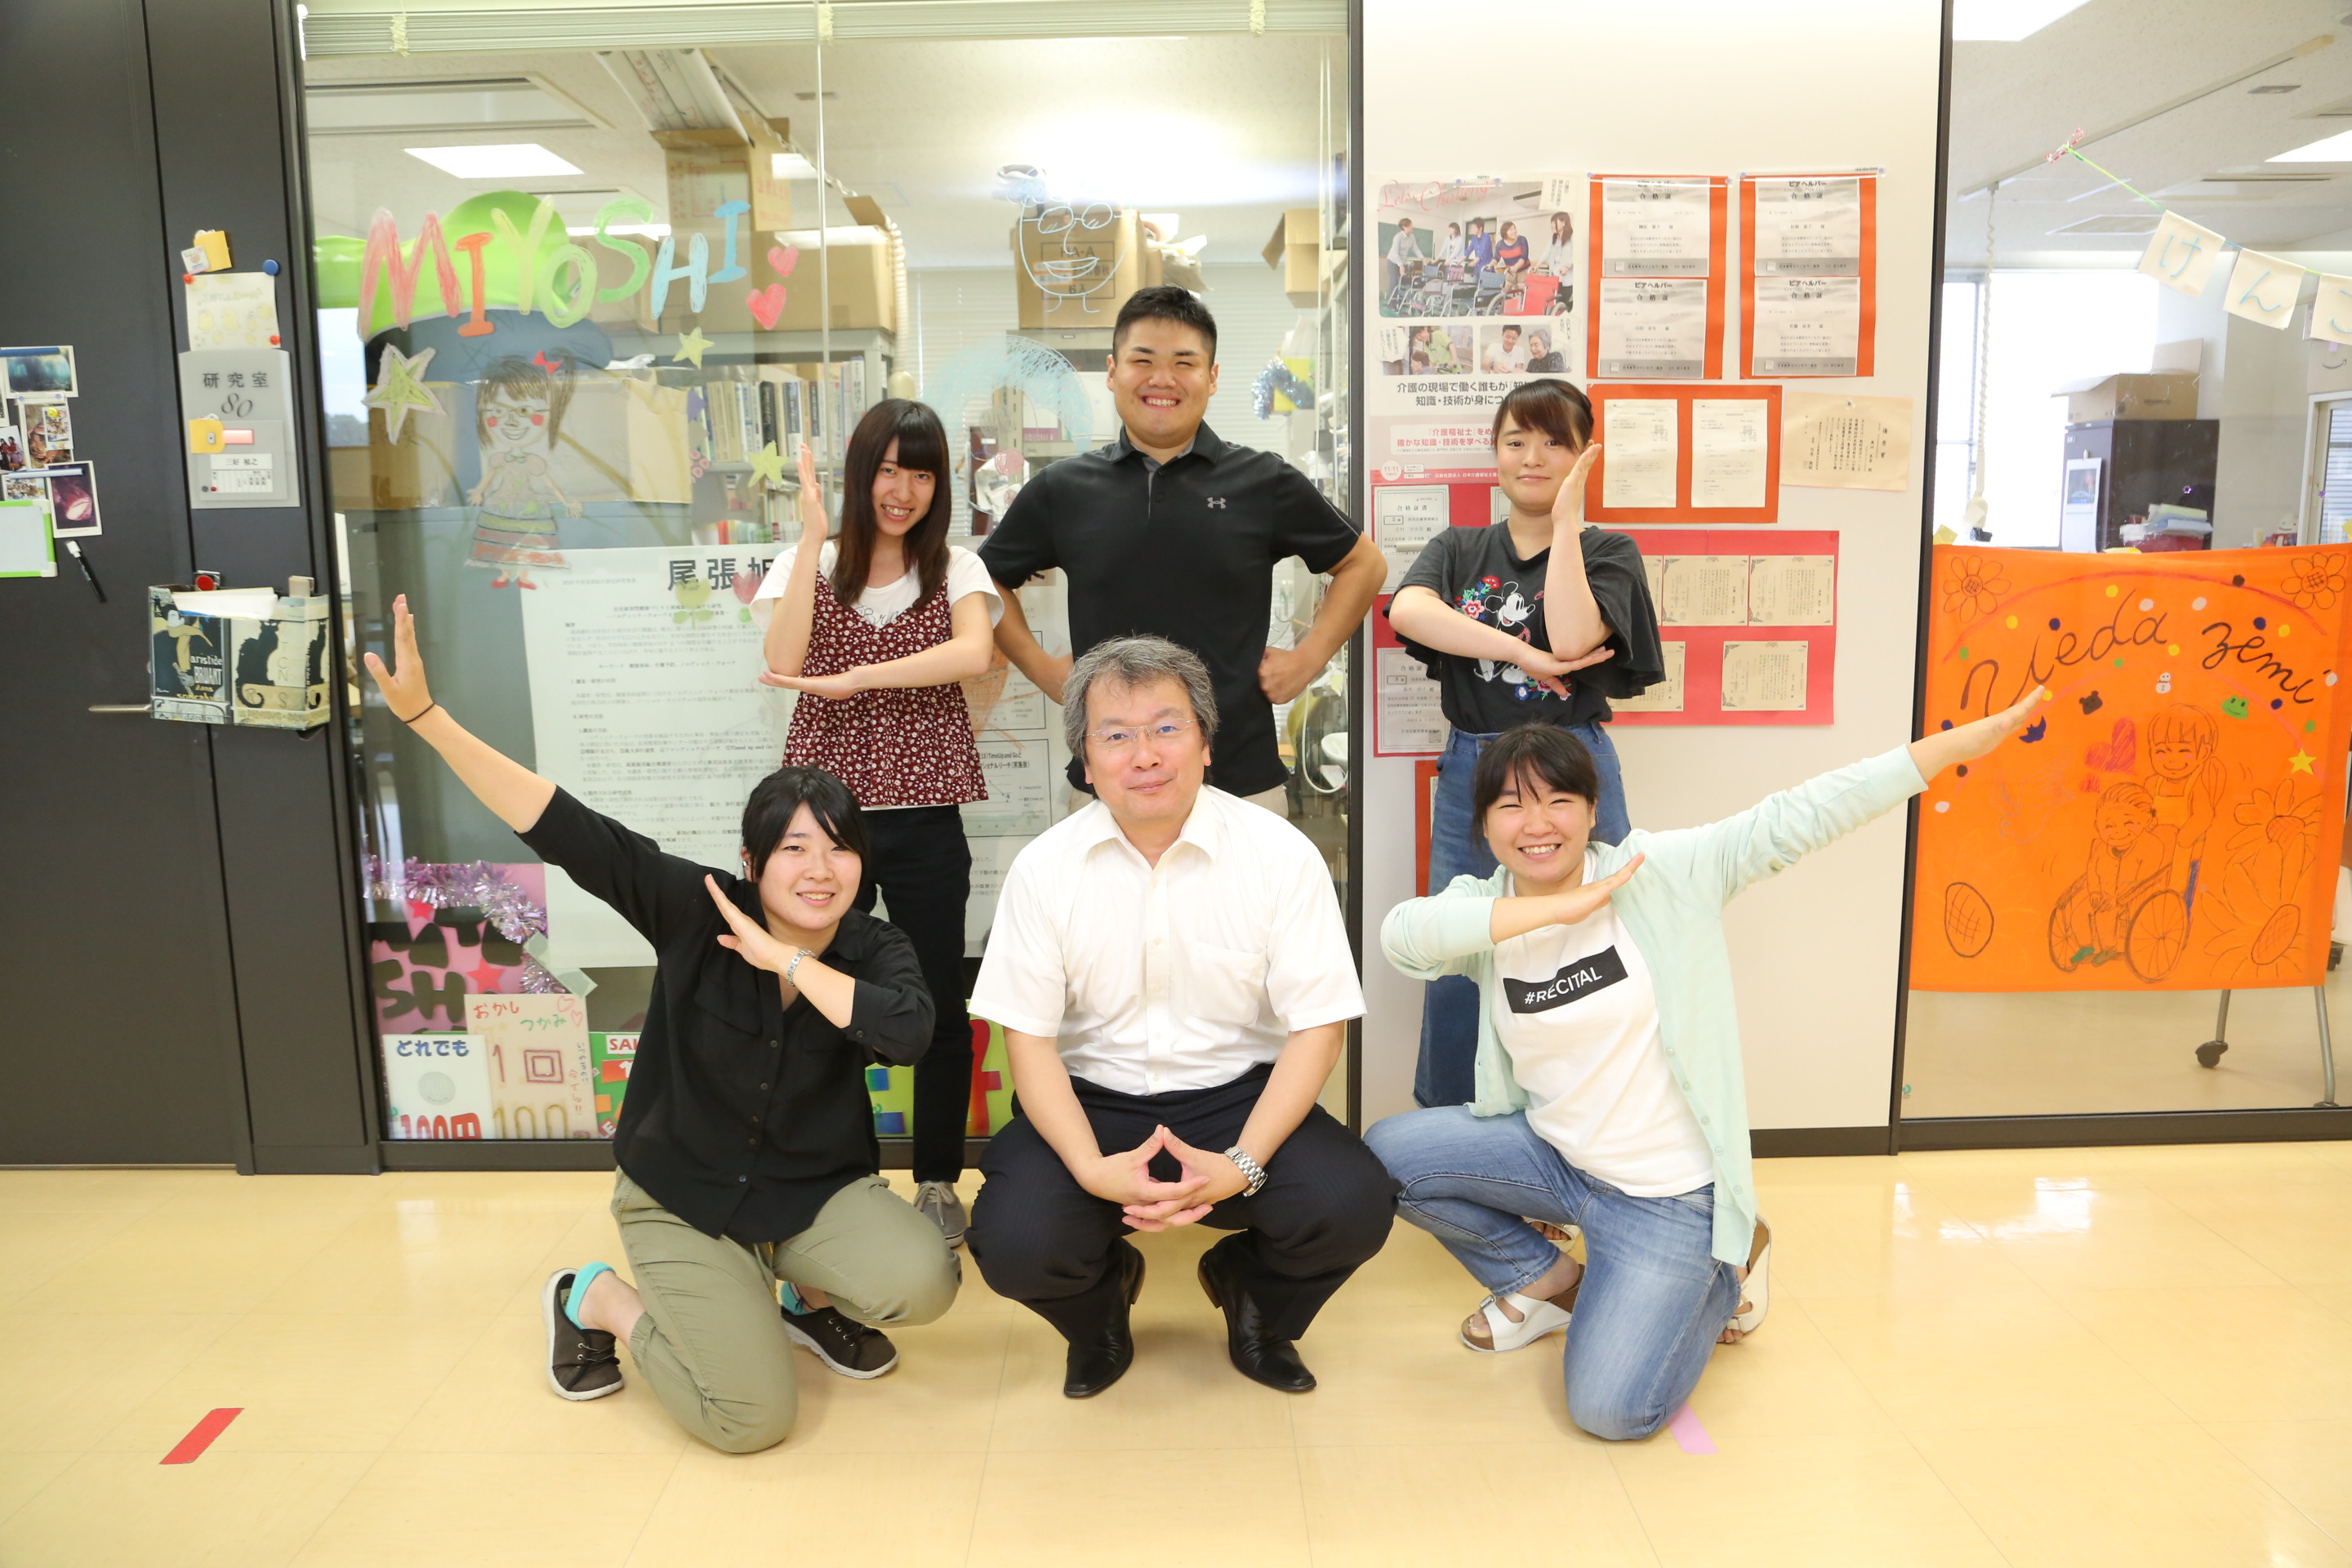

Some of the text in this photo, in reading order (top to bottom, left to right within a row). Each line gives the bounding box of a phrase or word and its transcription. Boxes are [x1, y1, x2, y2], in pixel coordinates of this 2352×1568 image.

[357, 195, 751, 340] MIYOSHI
[203, 372, 269, 388] 研究室
[1397, 381, 1528, 393] 介護の現場で働く誰もが「知
[1416, 395, 1506, 406] 知識・技術が身につ
[2202, 621, 2332, 704] zemi
[1524, 967, 1603, 1004] #RECITAL
[474, 1001, 519, 1019] おかし
[520, 1014, 567, 1031] つかみ
[396, 1040, 470, 1058] どれでも
